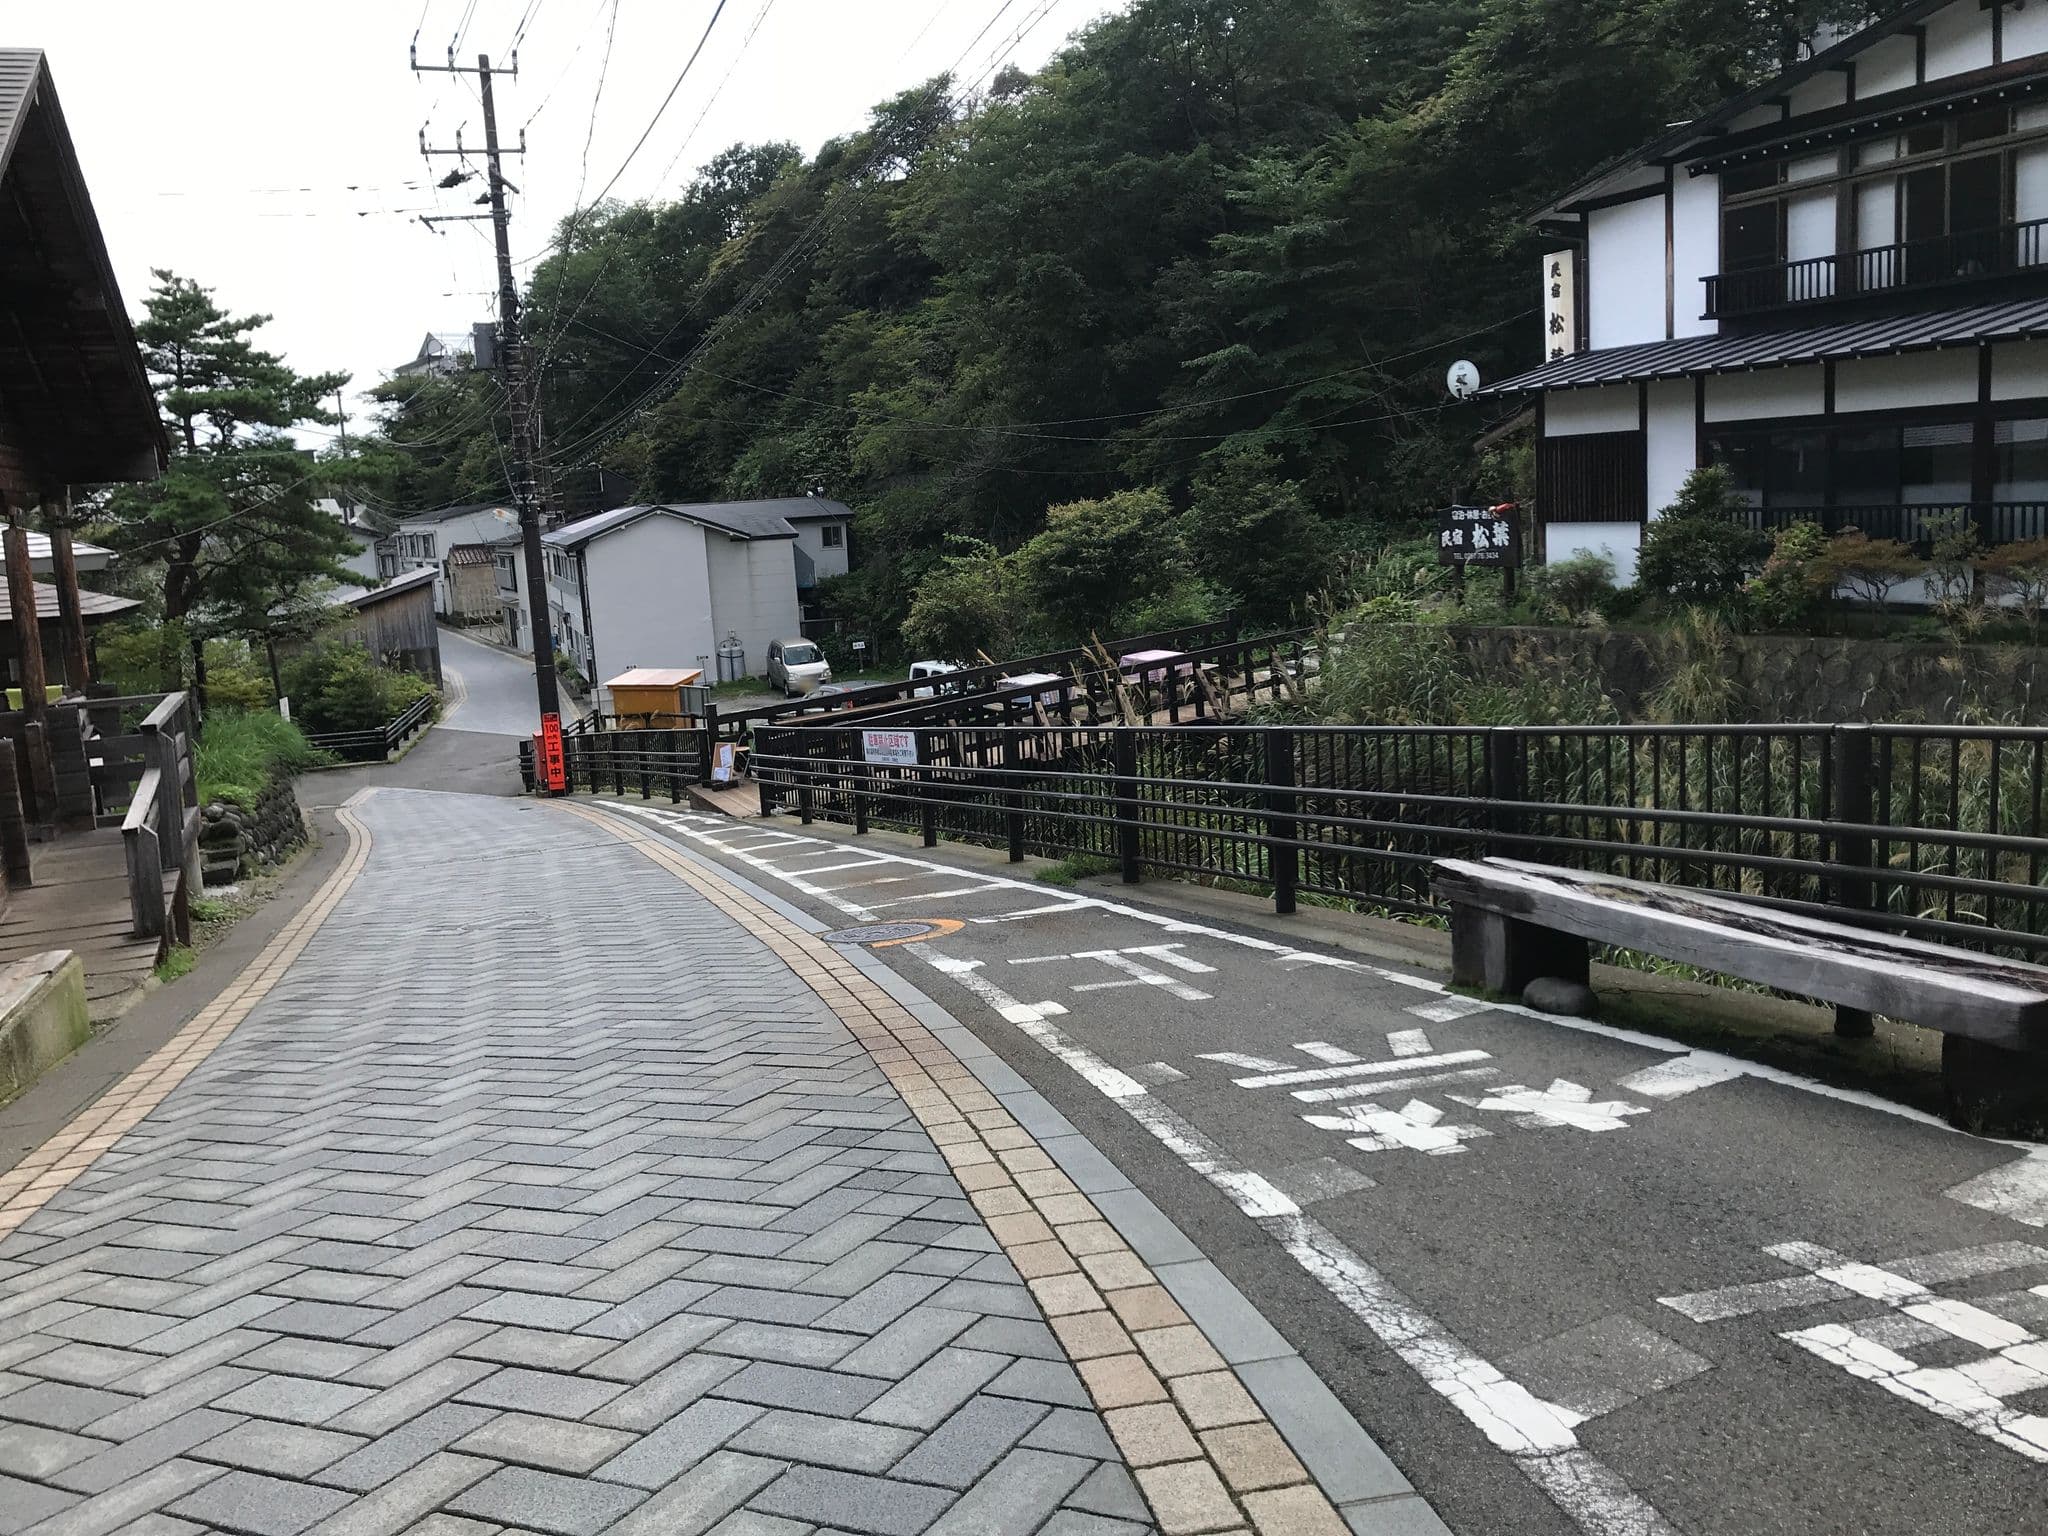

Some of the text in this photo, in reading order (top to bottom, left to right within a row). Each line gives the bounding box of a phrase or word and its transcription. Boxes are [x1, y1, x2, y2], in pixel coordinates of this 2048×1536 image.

[1550, 261, 1562, 299] 民宿
[1441, 520, 1510, 549] 民宿 松葉
[544, 724, 559, 734] 100
[547, 742, 562, 777] 工事中
